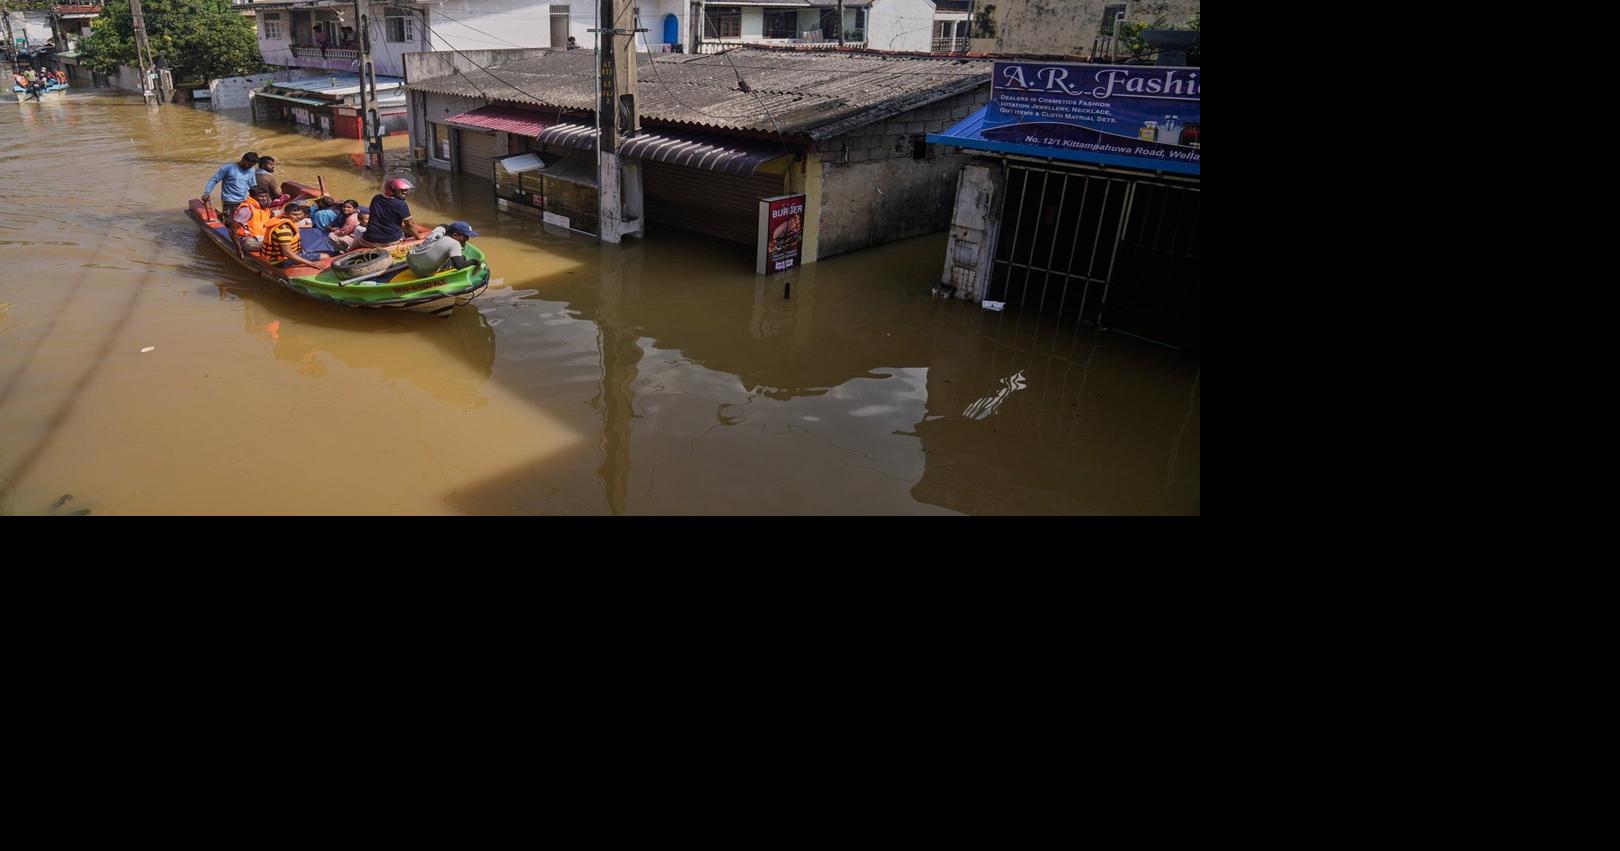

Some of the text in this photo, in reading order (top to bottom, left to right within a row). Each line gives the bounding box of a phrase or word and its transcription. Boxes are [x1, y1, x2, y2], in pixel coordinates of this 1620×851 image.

[1000, 94, 1029, 102] DEALERS
[1038, 97, 1077, 105] COSMETICS
[1031, 104, 1070, 112] JEWELLERY,
[1072, 107, 1112, 116] NECKLACE,
[1064, 113, 1094, 121] MATRIAL
[1043, 137, 1061, 145] 12/1
[1063, 139, 1132, 153] Kittampahuwa
[1134, 147, 1165, 158] Road,
[772, 204, 803, 218] BURGER
